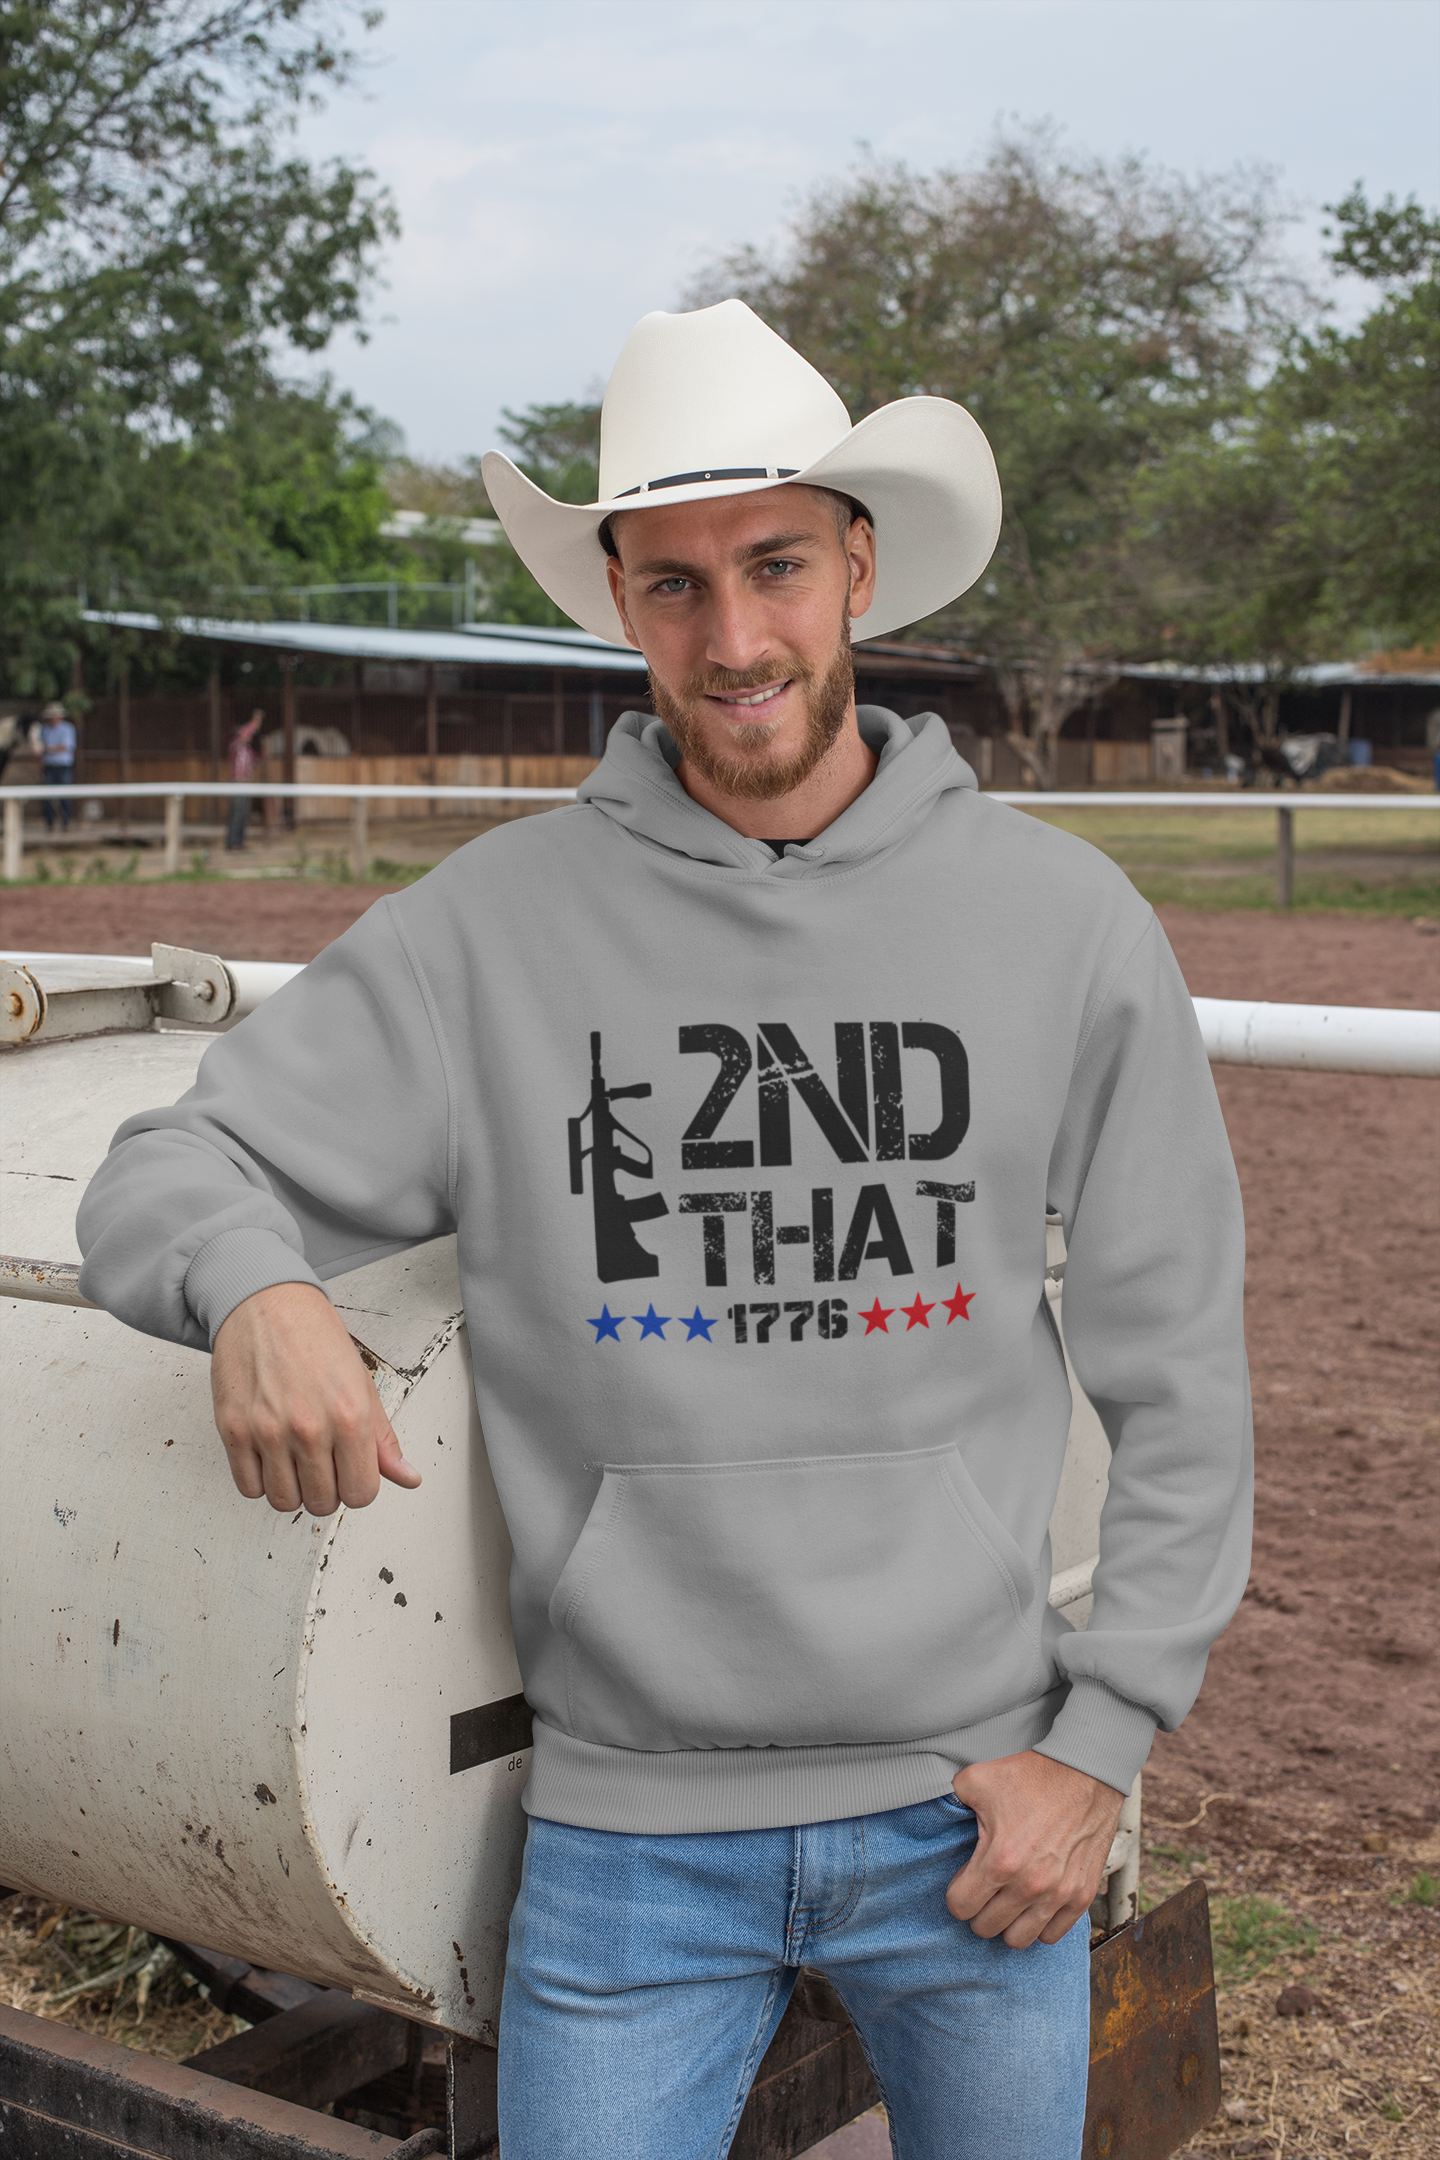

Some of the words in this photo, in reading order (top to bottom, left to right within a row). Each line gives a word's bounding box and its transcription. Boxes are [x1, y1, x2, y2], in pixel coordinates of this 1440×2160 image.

[679, 1021, 970, 1170] 2ND
[679, 1180, 976, 1286] THAT
[727, 1299, 848, 1344] 1776
[508, 1756, 523, 1771] de
